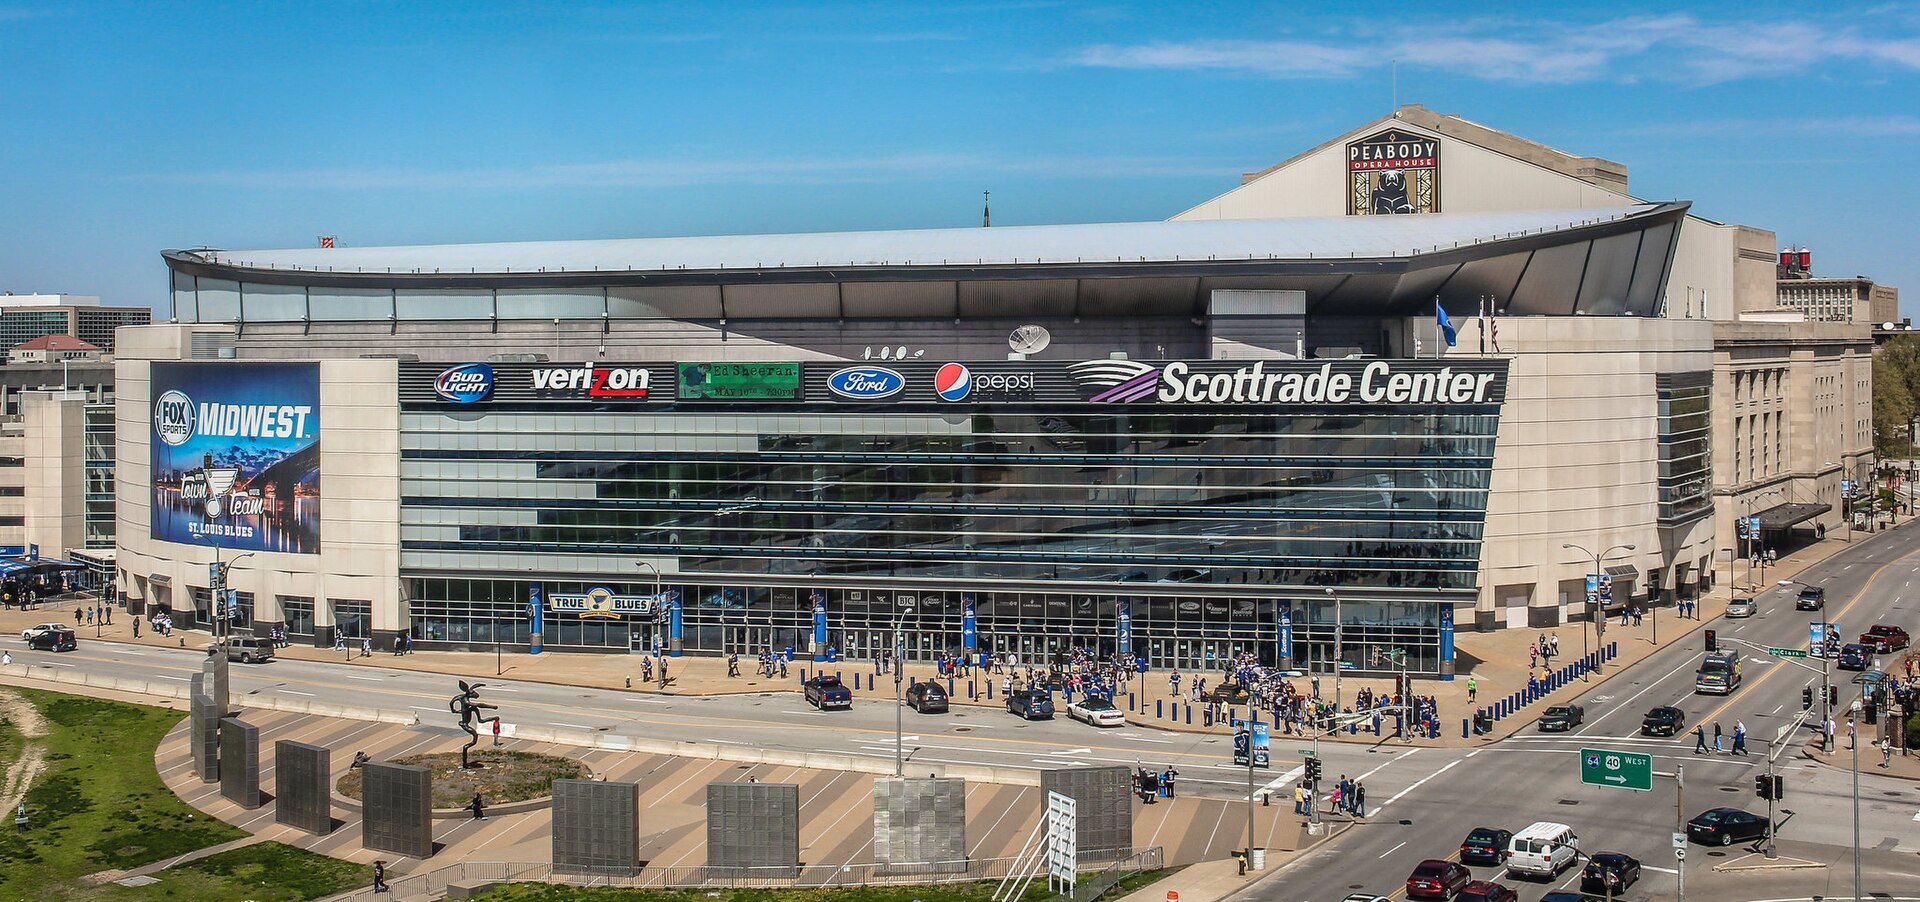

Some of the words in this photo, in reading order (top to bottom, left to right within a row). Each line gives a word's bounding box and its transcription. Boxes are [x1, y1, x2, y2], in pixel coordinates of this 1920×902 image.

[1351, 143, 1435, 160] PEABODY
[1354, 161, 1390, 169] OPERA
[1396, 158, 1432, 167] HOUSE
[448, 371, 485, 383] BUD
[714, 365, 729, 377] Ed
[532, 361, 650, 397] verizon
[843, 371, 888, 393] Ford
[975, 371, 1035, 393] pepsi
[1158, 360, 1352, 403] Scottrade
[441, 382, 487, 393] LIGHT
[714, 388, 735, 397] MAY
[163, 401, 187, 425] FOX
[198, 402, 311, 439] MIDWEST
[162, 424, 187, 435] SPORTS
[188, 522, 199, 533] ST.
[200, 523, 223, 535] LOUIS
[224, 525, 253, 538] BLUES
[555, 598, 584, 608] TRUE
[615, 599, 647, 610] BLUES
[1587, 757, 1599, 765] 64
[1607, 758, 1619, 767] 40
[1625, 756, 1647, 766] WEST
